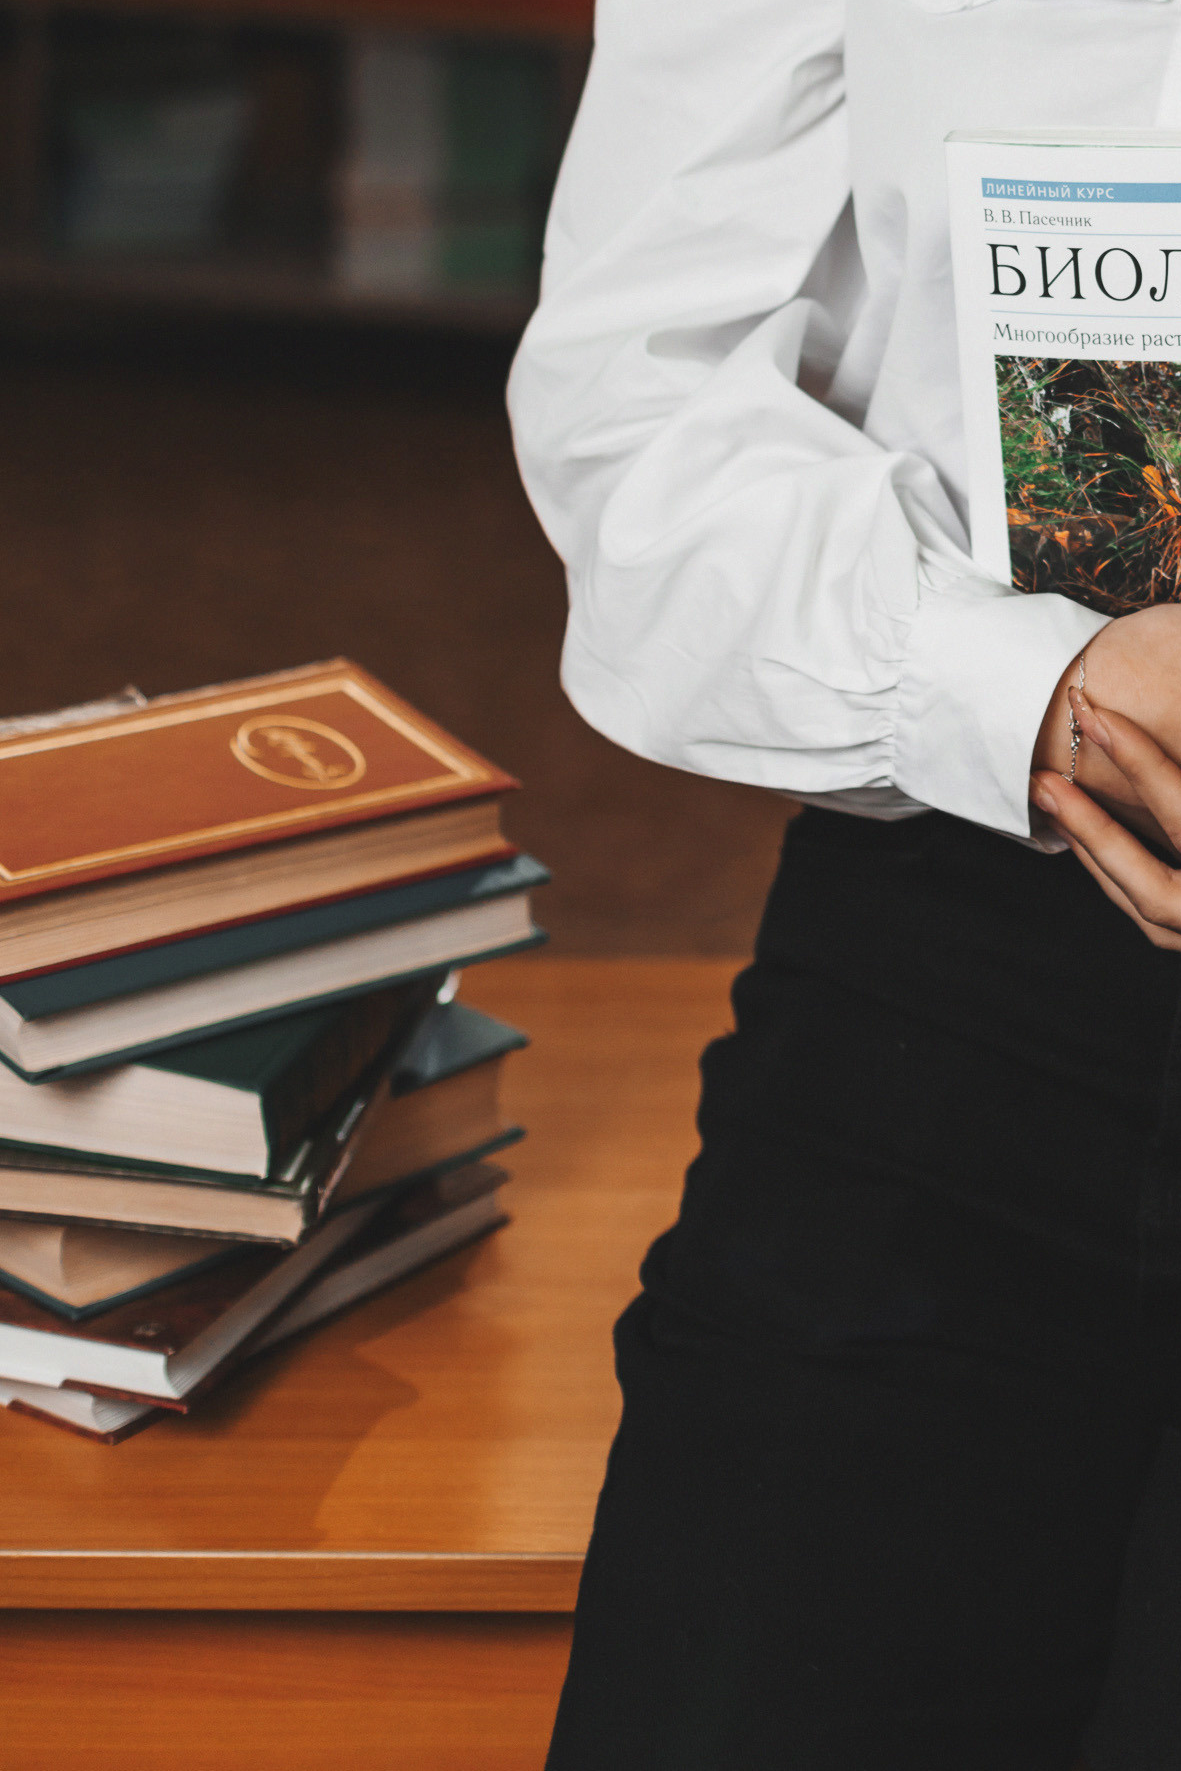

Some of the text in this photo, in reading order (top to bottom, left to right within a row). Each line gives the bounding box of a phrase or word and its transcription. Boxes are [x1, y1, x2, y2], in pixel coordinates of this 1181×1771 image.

[985, 182, 1115, 200] ЛИНЕЙНЫЙ КУРС
[983, 208, 1093, 227] В. В. Пасечник
[993, 322, 1135, 350] Многообразие
